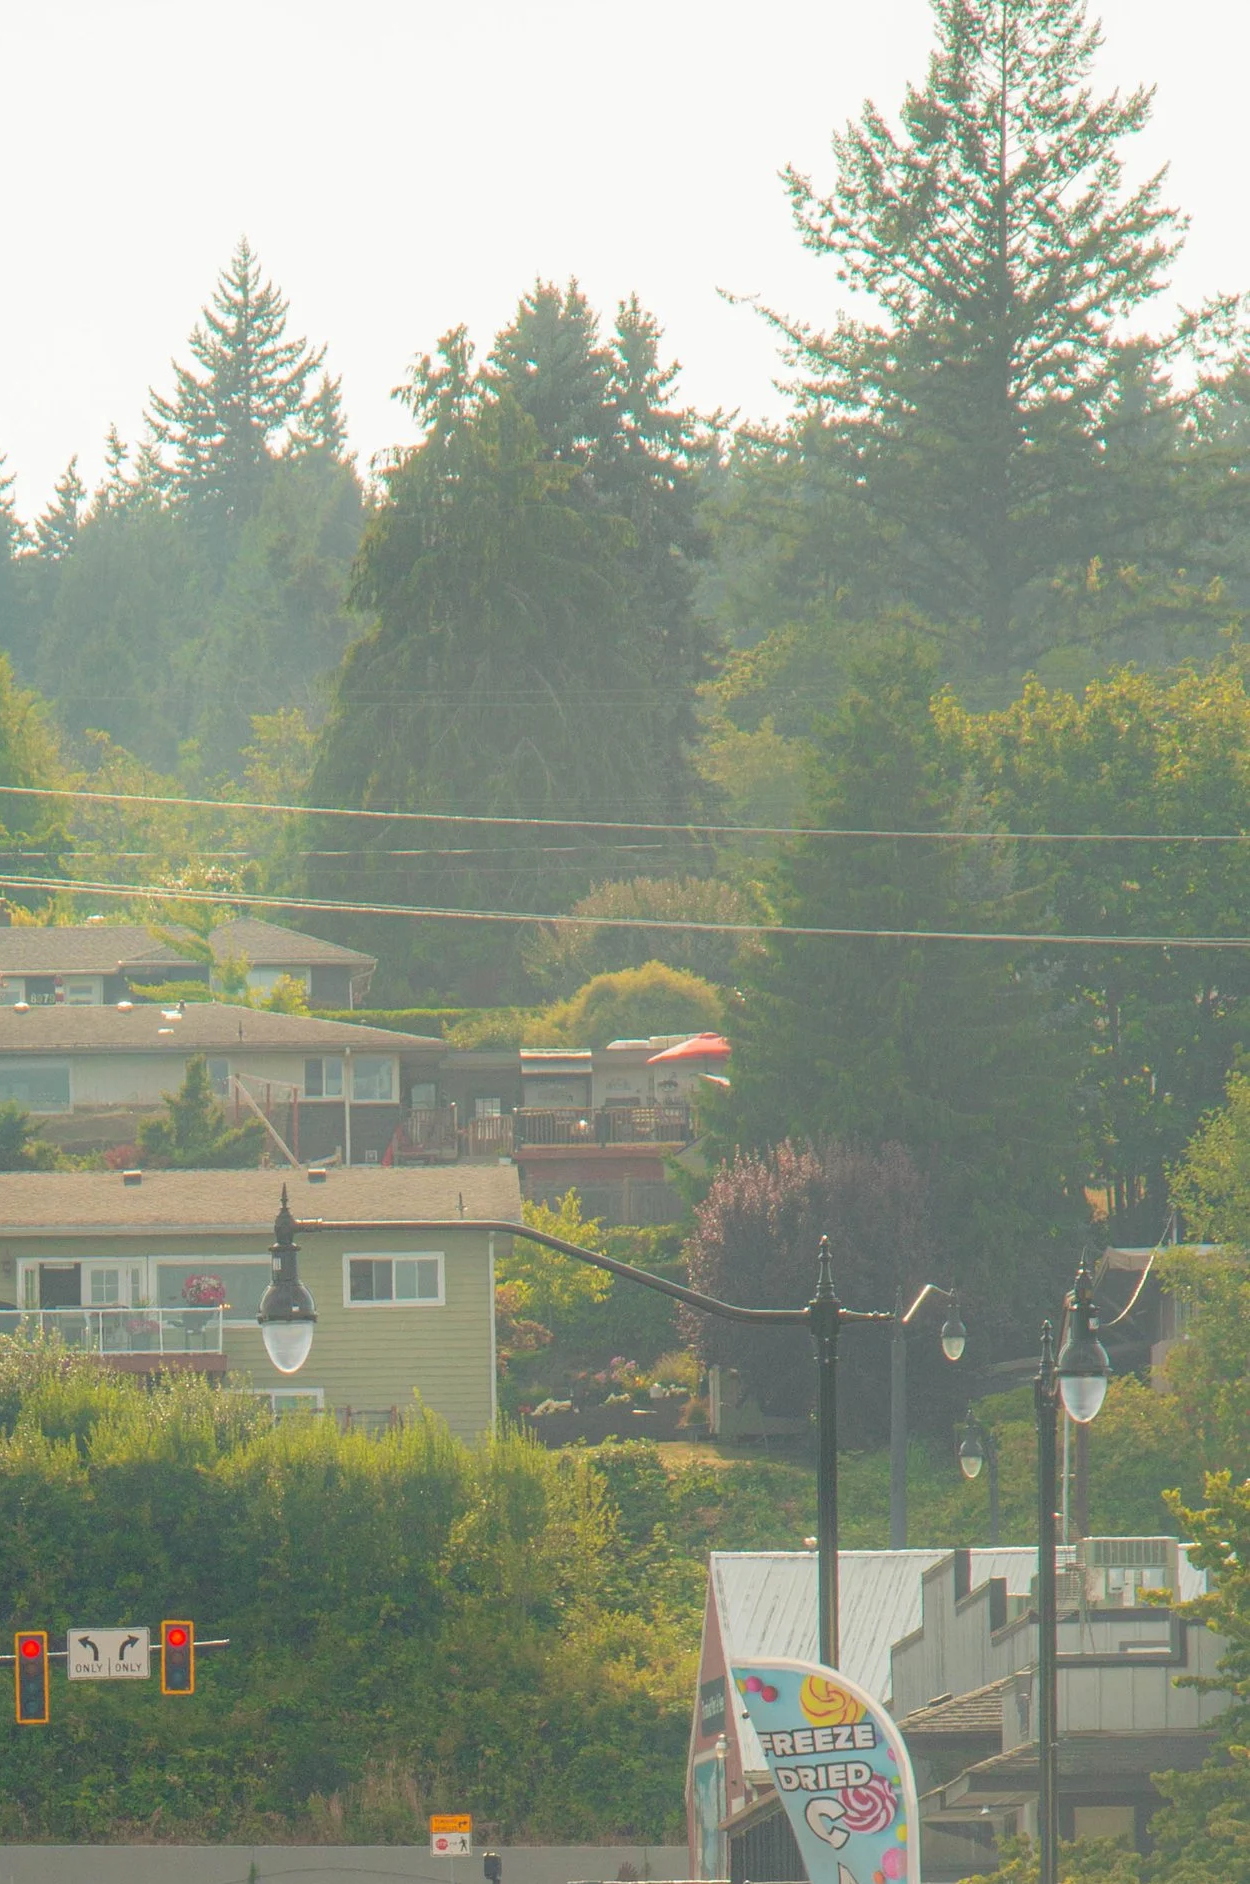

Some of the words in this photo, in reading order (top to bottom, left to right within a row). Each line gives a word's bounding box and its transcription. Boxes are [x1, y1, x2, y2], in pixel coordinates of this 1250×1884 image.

[75, 1663, 103, 1673] ONLY
[115, 1663, 142, 1673] ONLY
[756, 1722, 877, 1758] FREEZE
[775, 1760, 873, 1792] DRIED
